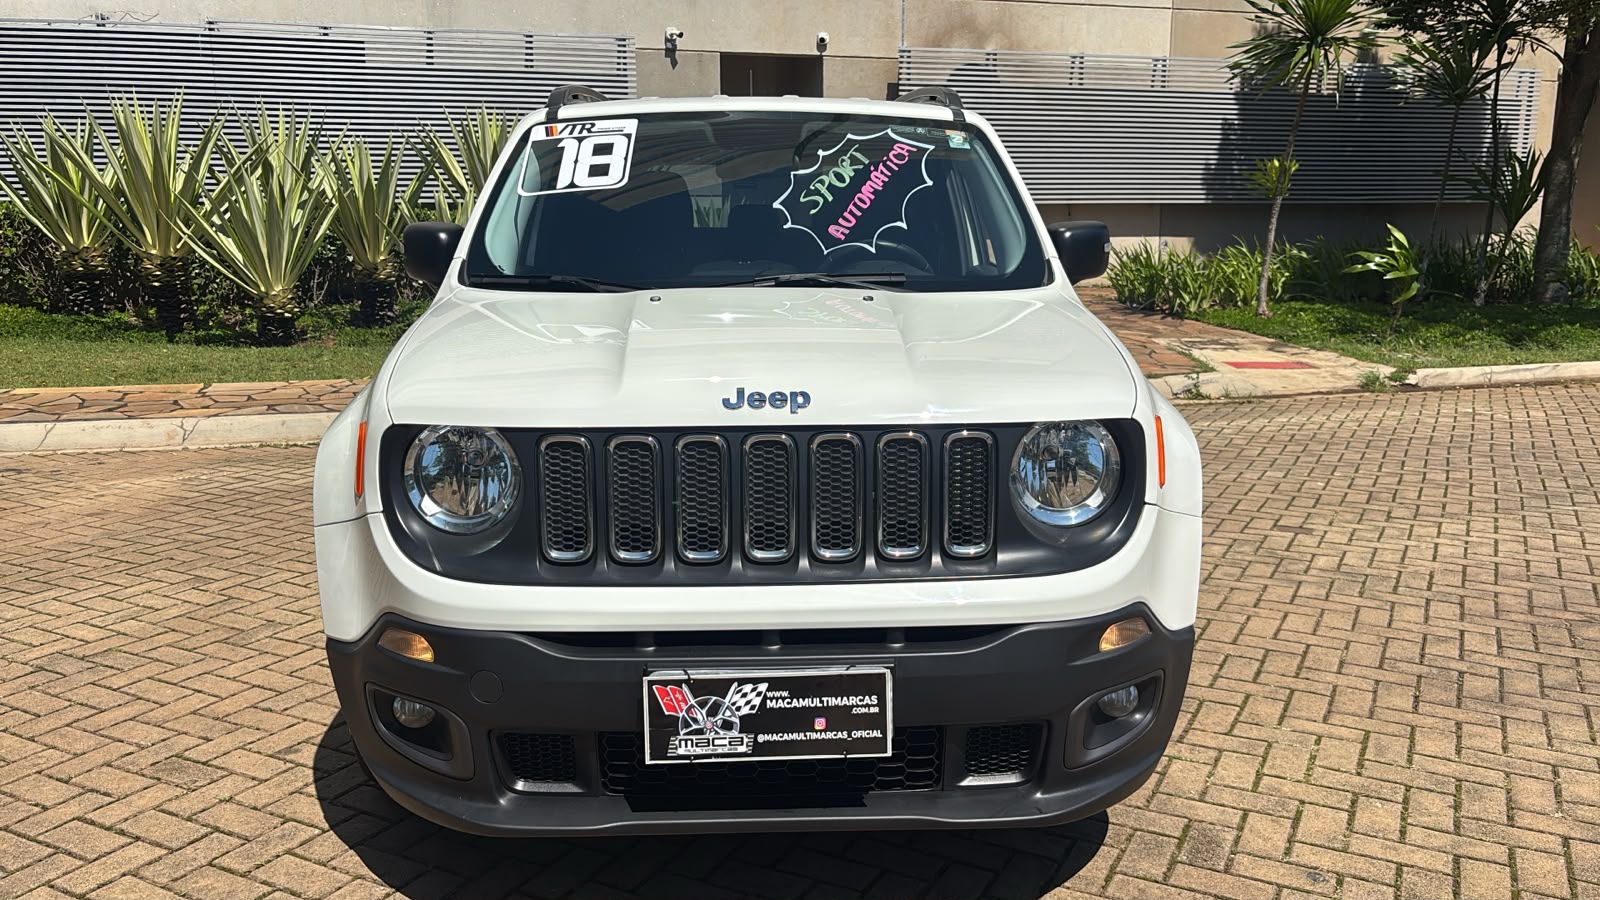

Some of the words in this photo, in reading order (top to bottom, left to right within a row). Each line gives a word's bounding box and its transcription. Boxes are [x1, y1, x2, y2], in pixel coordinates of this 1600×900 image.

[556, 135, 629, 190] 18
[799, 143, 870, 215] SPORT
[721, 387, 811, 415] Jeep
[766, 695, 878, 709] MACAMULTIMARCAS
[757, 729, 883, 743] @MACAMULTIMARCAS_OFICIAL
